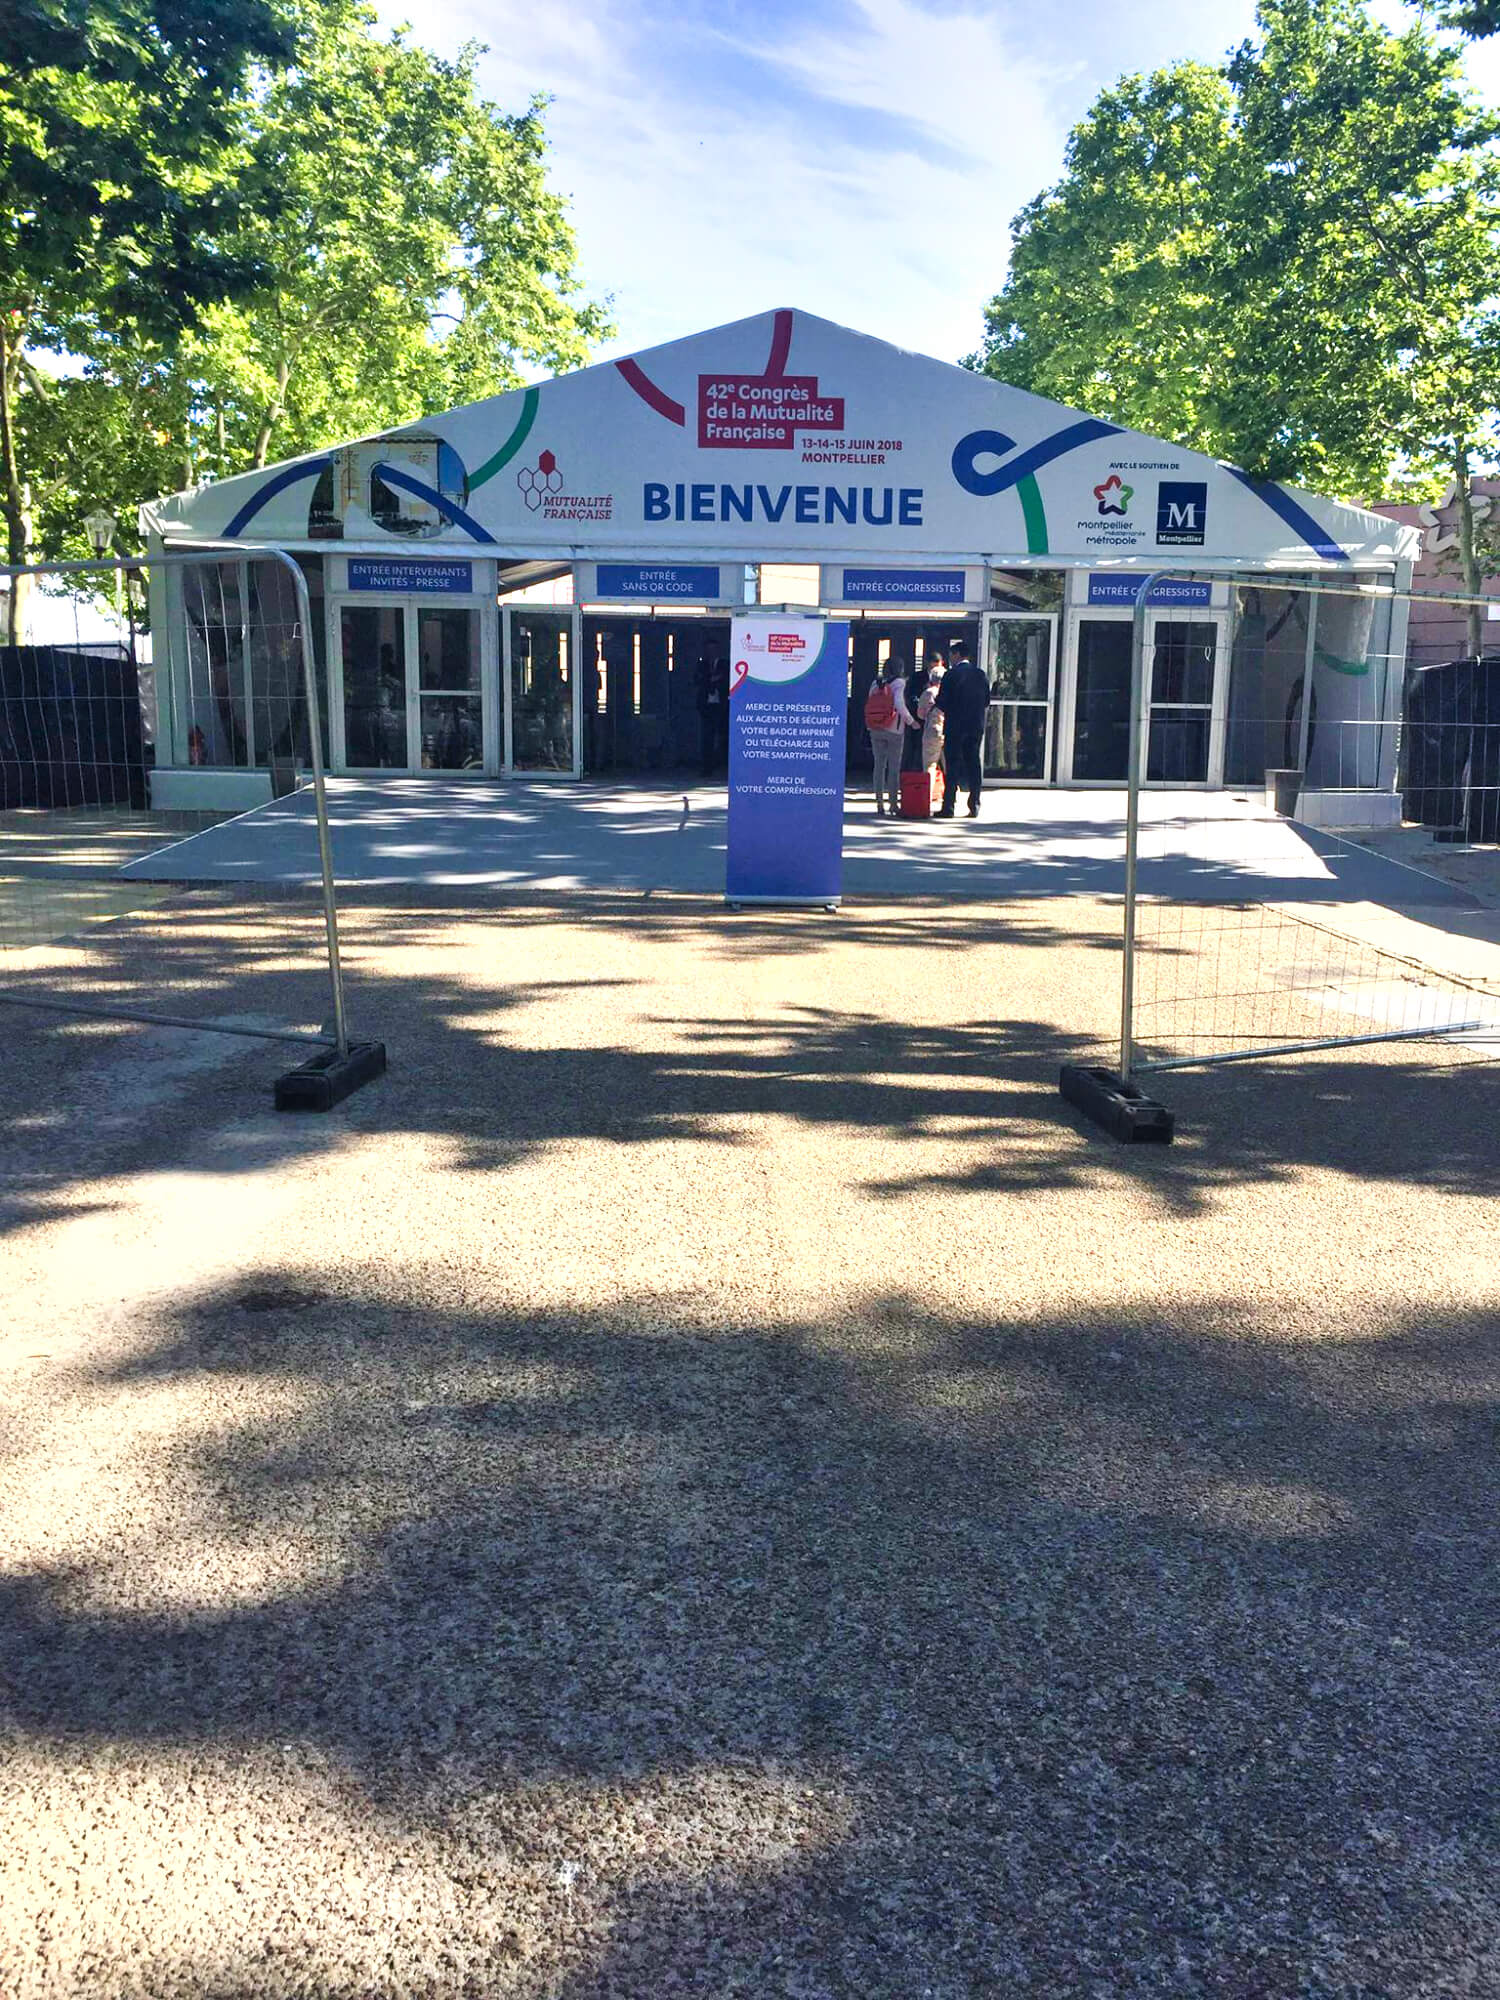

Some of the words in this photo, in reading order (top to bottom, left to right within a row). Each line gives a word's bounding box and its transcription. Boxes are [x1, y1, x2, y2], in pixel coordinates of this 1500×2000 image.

[738, 384, 809, 404] Congrès
[706, 403, 728, 419] de
[731, 404, 746, 420] la
[749, 404, 834, 421] Mutualité
[706, 423, 785, 442] Française
[801, 438, 846, 450] 13-14-15
[847, 439, 875, 450] JUIN
[877, 440, 903, 451] 2018
[801, 453, 885, 465] MONTPELLIER
[543, 494, 613, 507] MUTUALITÉ
[643, 482, 923, 526] BIENVENUE
[543, 509, 612, 523] FRANÇAISE
[1166, 502, 1197, 528] M
[1158, 534, 1202, 543] Montpellier
[353, 563, 390, 575] ENTRÉE
[392, 566, 467, 577] INTERVENANTS
[639, 570, 677, 580] ENTRÉE
[416, 577, 451, 588] PRESSE
[622, 582, 648, 592] SANS
[649, 582, 666, 593] QR
[666, 583, 694, 592] CODE
[847, 581, 883, 592] ENTRÉE
[885, 582, 961, 593] CONGRESSISTES
[1092, 584, 1129, 596] ENTRÉE
[745, 703, 771, 711] MERCI
[773, 703, 784, 712] DE
[736, 715, 754, 723] AUX
[755, 715, 787, 724] AGENTS
[789, 716, 800, 724] DE
[740, 727, 768, 735] VOTRE
[769, 727, 798, 736] BADGE
[745, 738, 758, 747] OU
[813, 740, 830, 749] SUR
[742, 750, 770, 758] VOTRE
[771, 750, 832, 761] SMARTPHONE.
[767, 776, 793, 784] MERCI
[794, 776, 806, 785] DE
[736, 785, 764, 793] VOTRE
